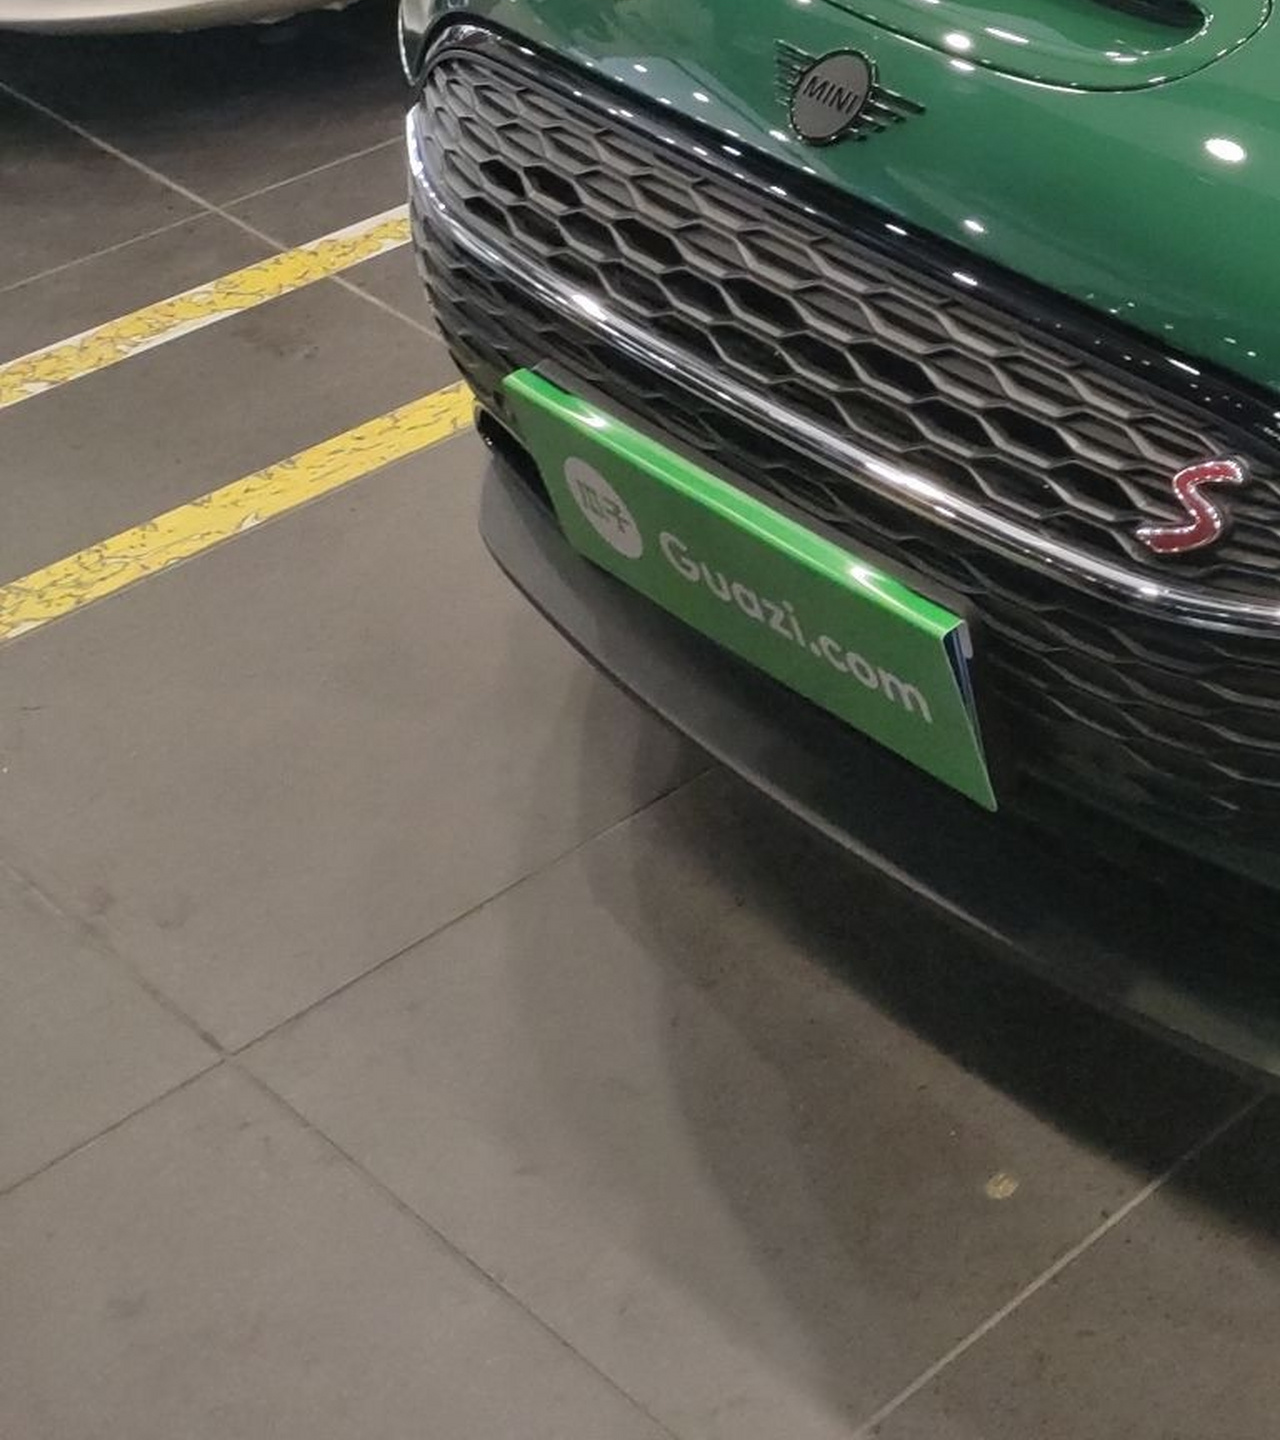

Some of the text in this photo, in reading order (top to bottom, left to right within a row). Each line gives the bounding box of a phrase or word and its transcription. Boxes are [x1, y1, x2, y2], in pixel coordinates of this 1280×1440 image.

[803, 75, 861, 114] MINI
[1135, 460, 1244, 553] S
[658, 530, 933, 725] Guazi.com
